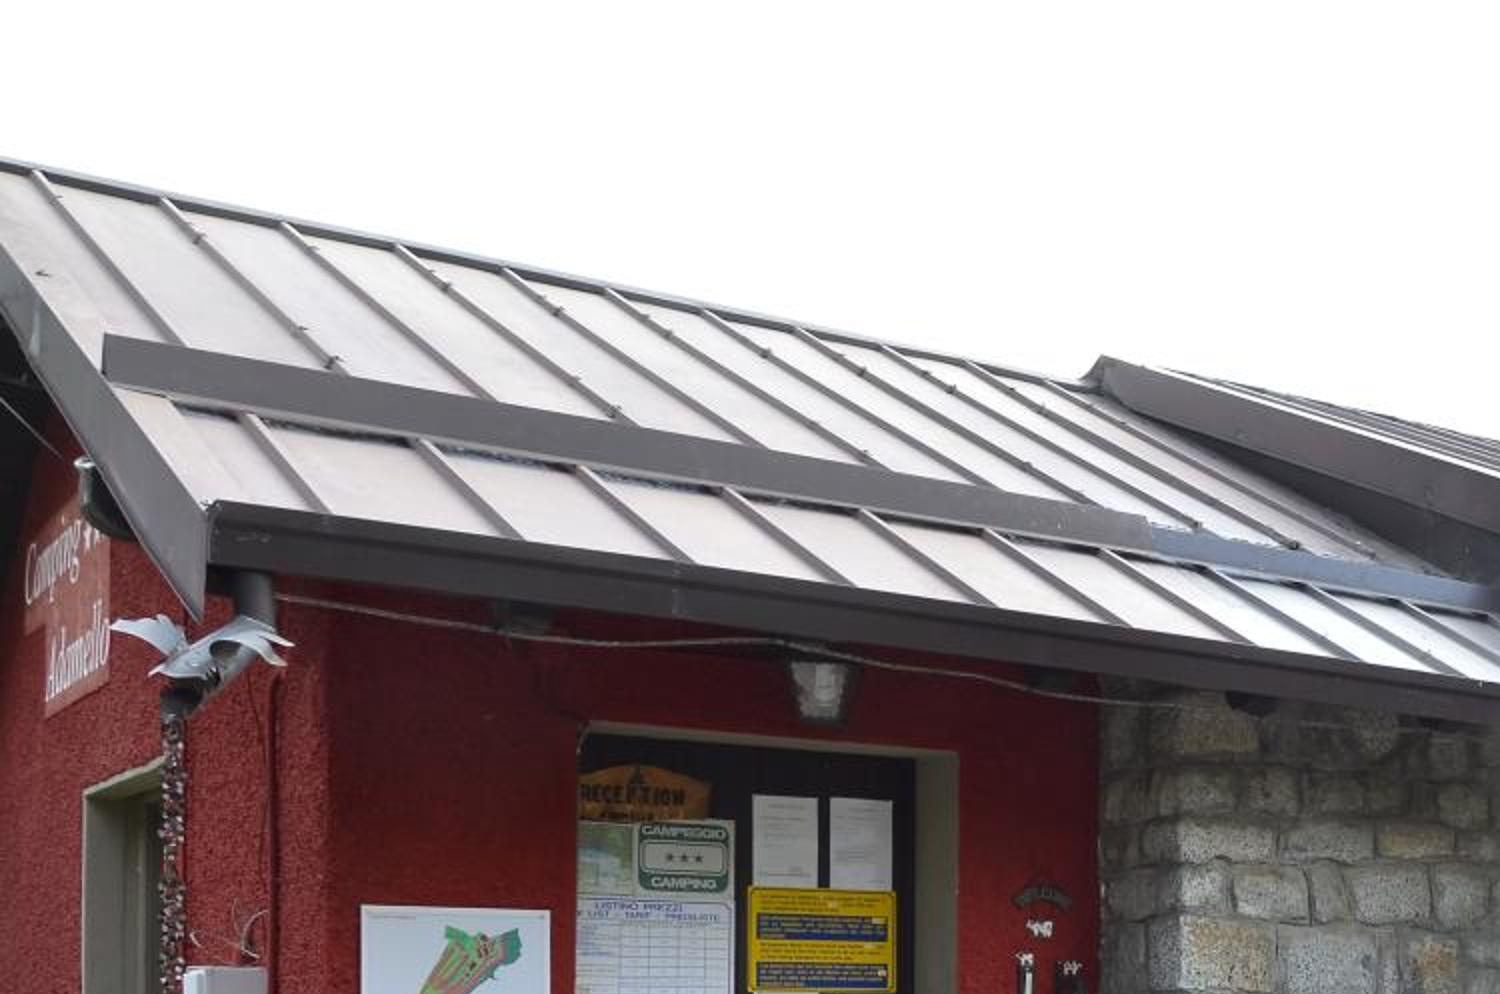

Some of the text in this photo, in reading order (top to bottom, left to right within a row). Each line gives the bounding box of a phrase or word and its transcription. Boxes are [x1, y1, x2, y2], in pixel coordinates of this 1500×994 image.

[25, 515, 81, 605] Camping
[578, 783, 685, 806] RECEPTION
[641, 824, 727, 840] CAMPEGGIO
[651, 876, 717, 890] CAMPING
[594, 902, 639, 912] LISTINO
